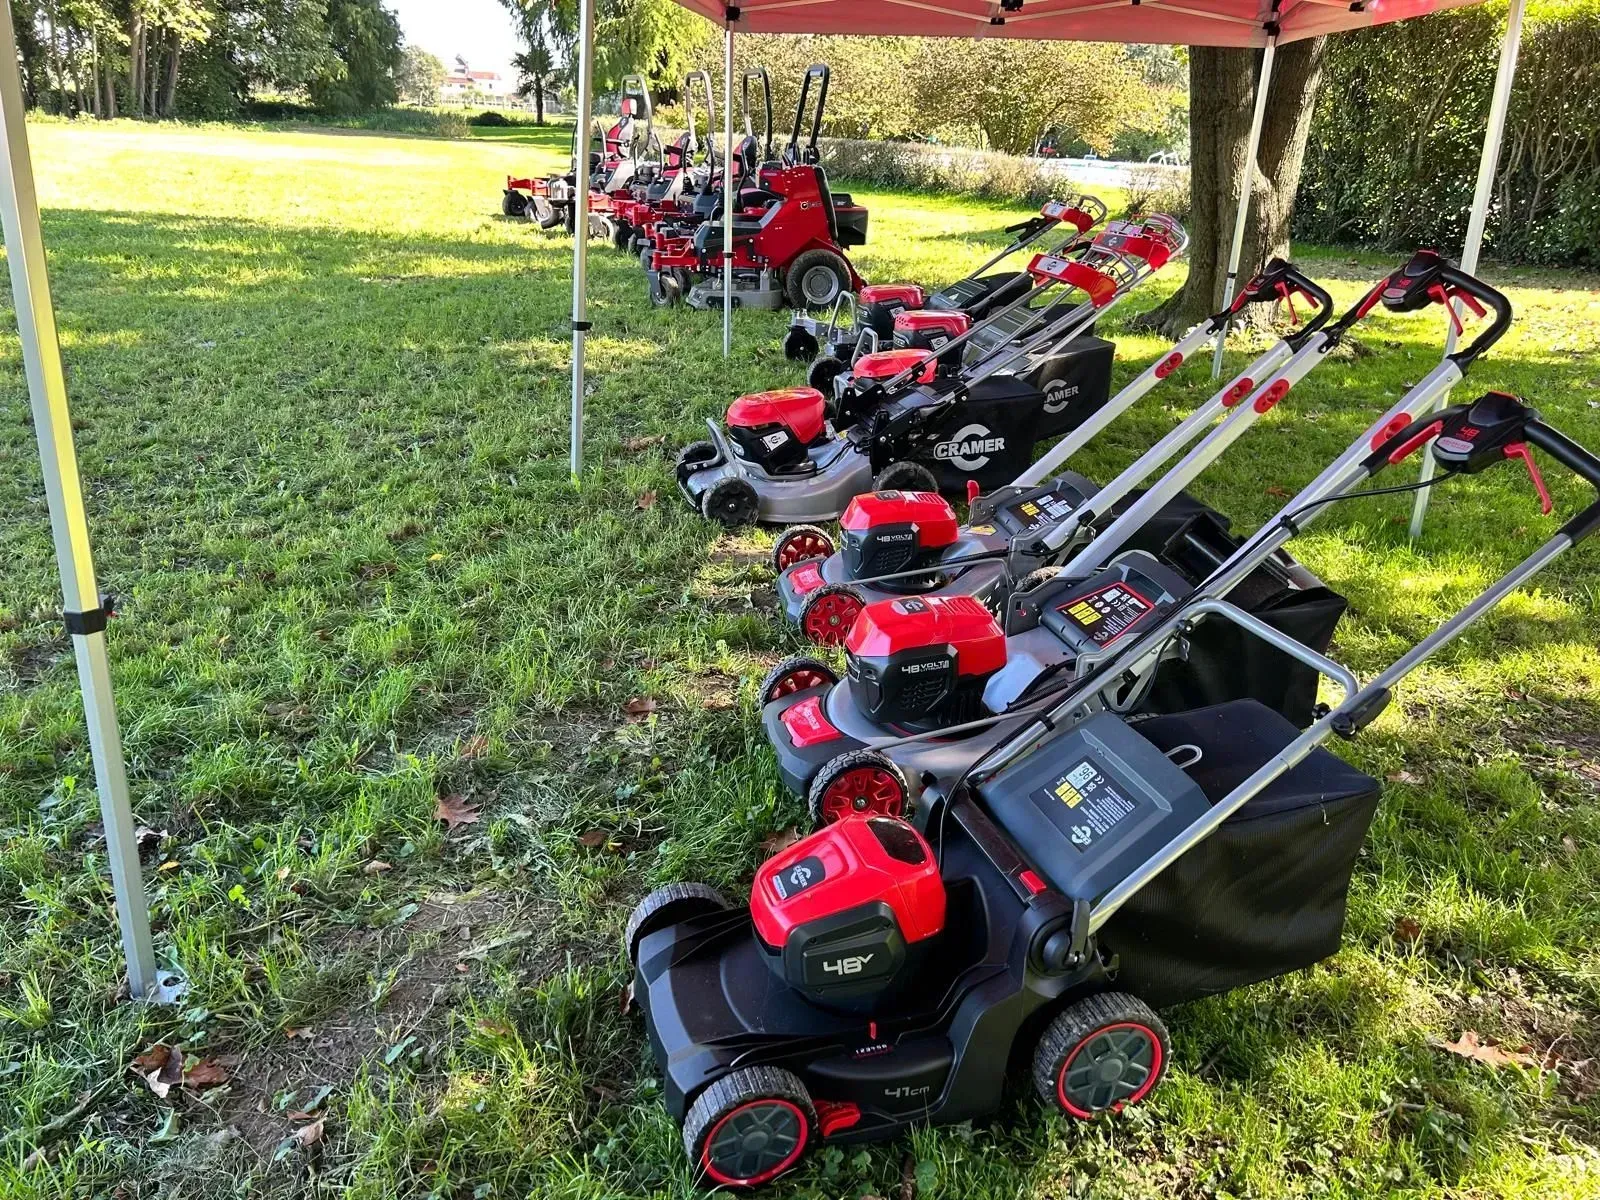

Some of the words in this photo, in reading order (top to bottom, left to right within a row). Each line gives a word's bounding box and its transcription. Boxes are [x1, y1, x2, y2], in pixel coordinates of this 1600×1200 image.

[1044, 385, 1080, 403] AMER
[1460, 425, 1480, 438] 48
[936, 437, 1005, 459] CRAMER
[876, 535, 891, 543] 48
[901, 664, 920, 674] 48
[920, 660, 945, 669] VOLT
[1078, 768, 1094, 780] 96
[793, 864, 808, 888] CRAMER
[884, 1085, 931, 1098] 41cm
